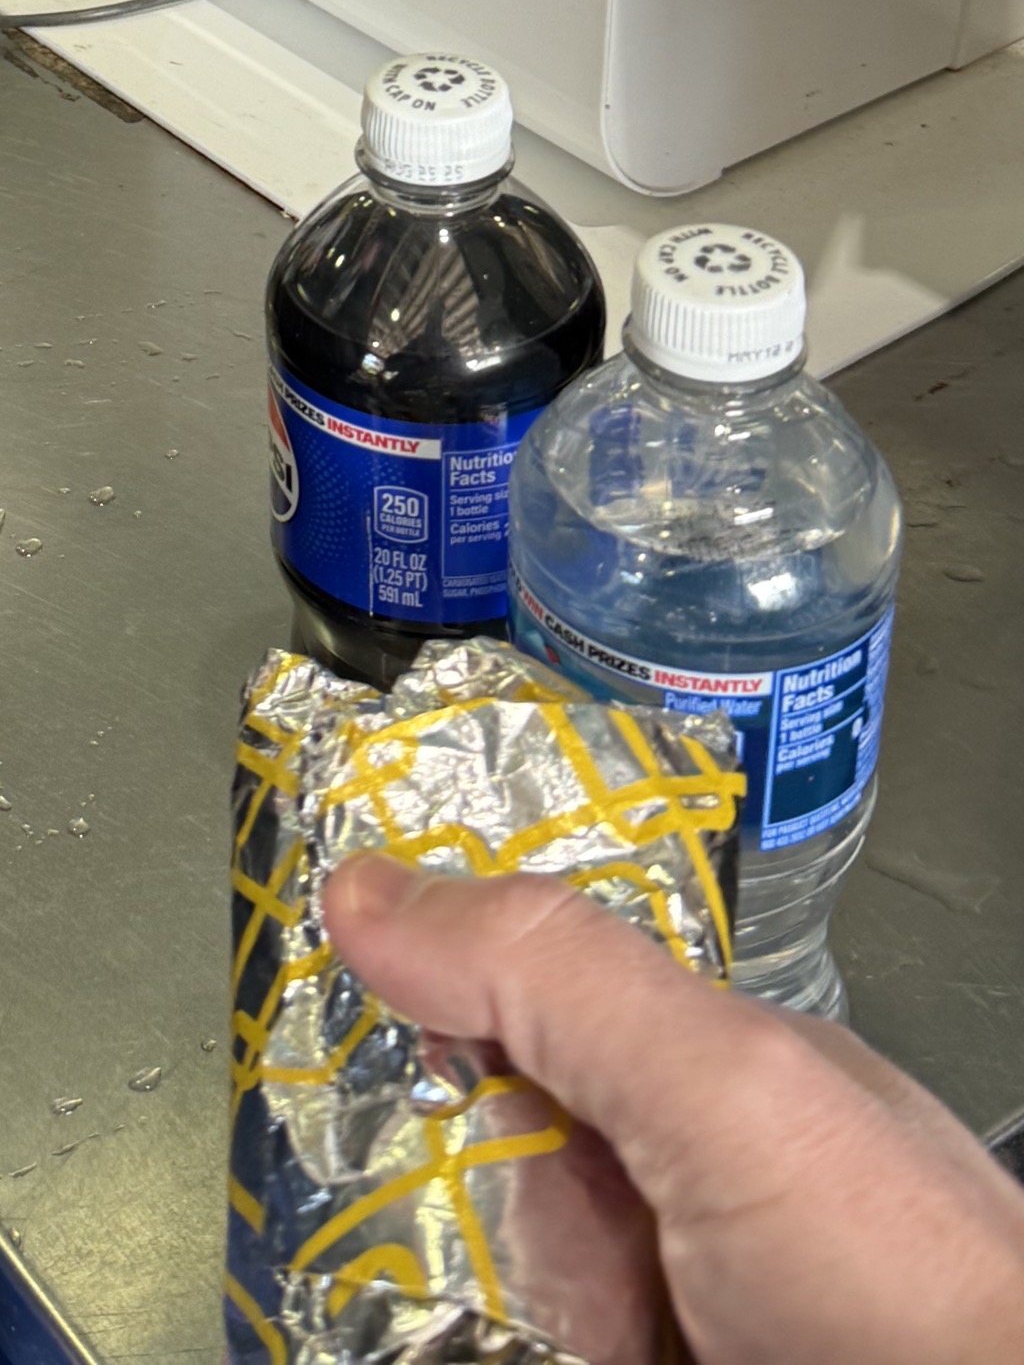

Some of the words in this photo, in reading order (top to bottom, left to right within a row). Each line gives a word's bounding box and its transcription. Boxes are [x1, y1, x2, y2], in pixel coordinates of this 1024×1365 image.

[384, 85, 411, 102] CAP
[411, 99, 437, 111] ON
[664, 266, 688, 283] ON
[715, 274, 780, 296] BOTTLE
[285, 387, 325, 425] PRIZES
[327, 415, 421, 453] INSTANTLY
[450, 450, 517, 471] Nutritio
[450, 470, 496, 486] Facts
[382, 492, 419, 517] 250
[450, 493, 492, 505] Serving
[379, 512, 422, 528] CALORIES
[457, 505, 489, 516] bottle
[395, 525, 420, 537] BOTTLE
[450, 520, 500, 534] Calories
[450, 536, 466, 545] per
[468, 531, 502, 543] serving
[374, 546, 390, 565] 20
[393, 550, 408, 569] FL
[409, 553, 427, 571] OZ
[374, 564, 403, 586] (1.25
[405, 571, 428, 592] PT)
[378, 584, 399, 604] 591
[402, 591, 424, 607] mL
[544, 614, 586, 653] CASH
[587, 643, 652, 681] PRIZES
[654, 669, 763, 693] INSTANTLY
[783, 649, 862, 694] Nutrition
[664, 691, 717, 714] Purified
[720, 698, 763, 716] Water
[782, 684, 835, 713] Facts
[781, 710, 822, 731] Serving
[789, 723, 823, 742] bottle
[777, 734, 835, 762] Calories
[795, 747, 832, 767] serving
